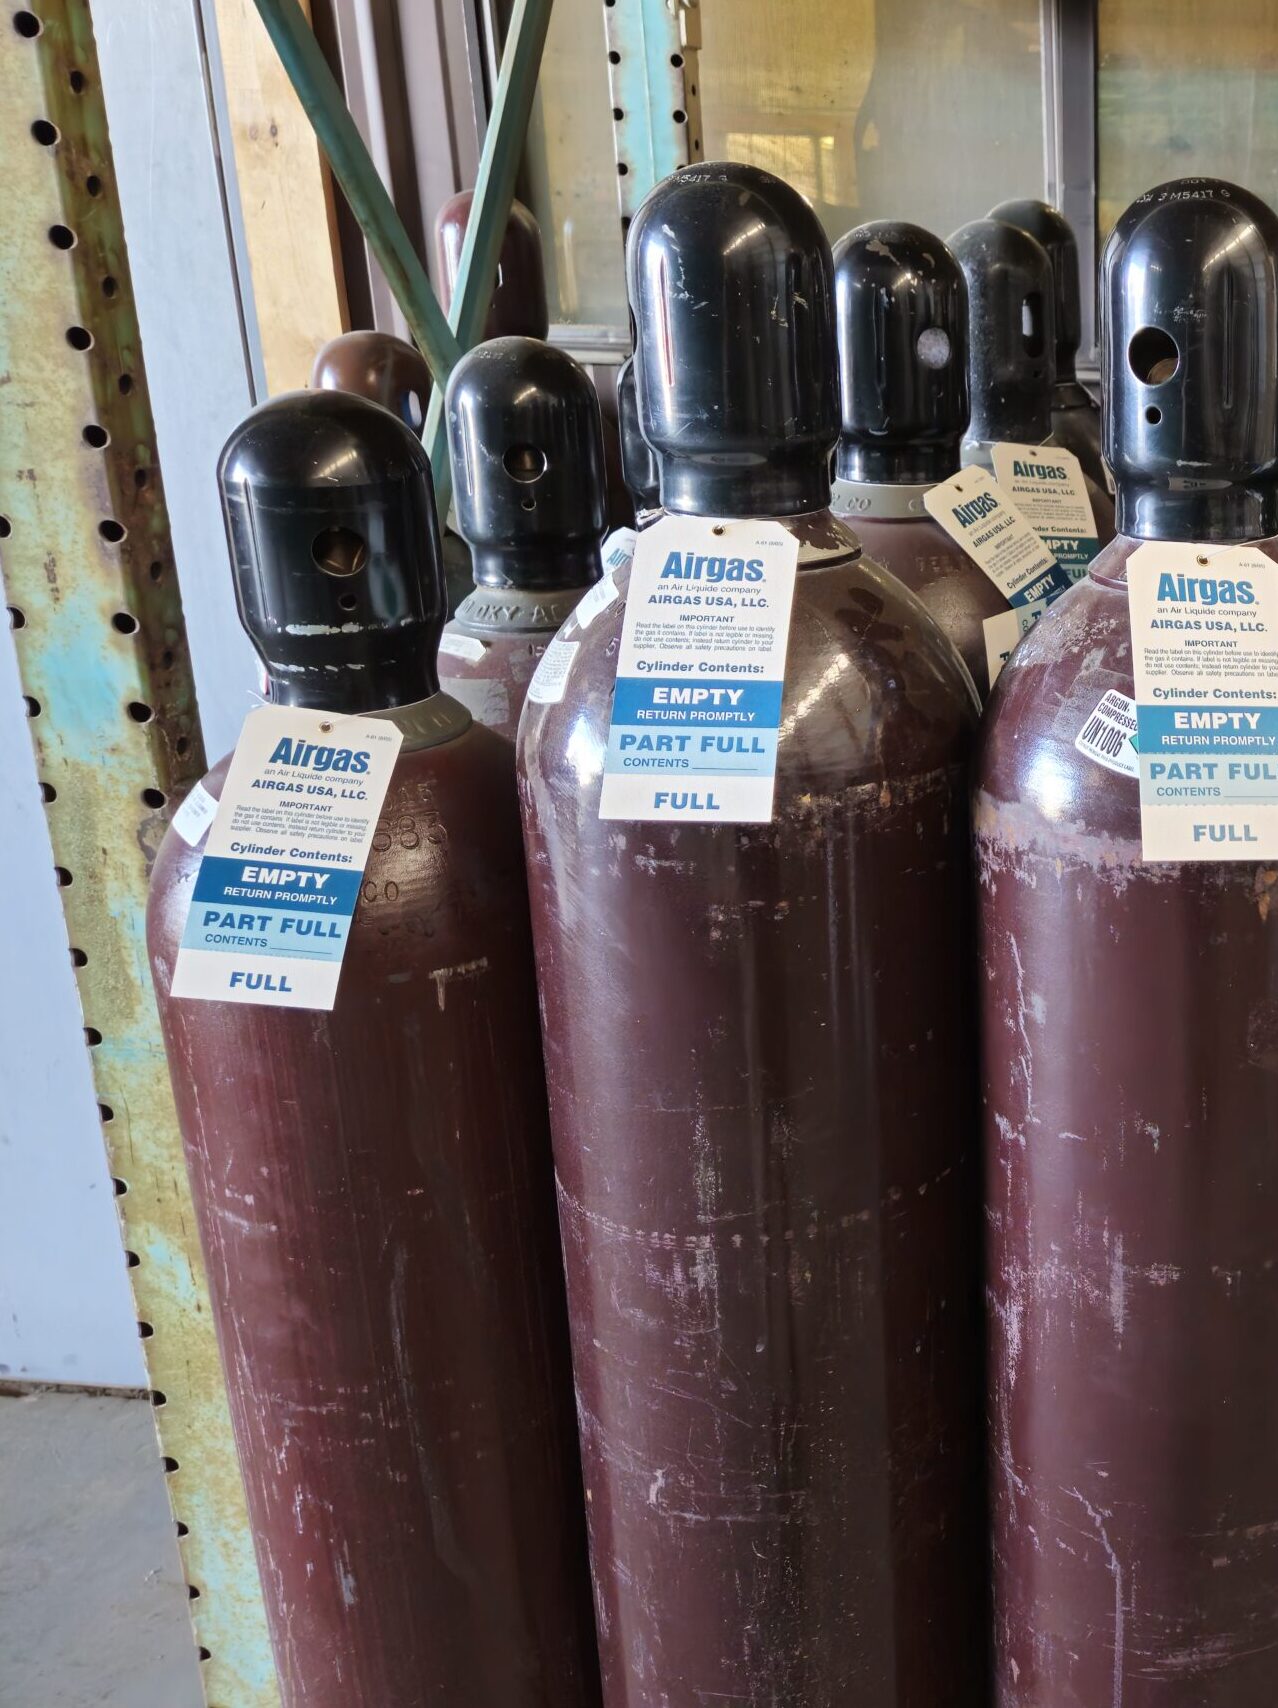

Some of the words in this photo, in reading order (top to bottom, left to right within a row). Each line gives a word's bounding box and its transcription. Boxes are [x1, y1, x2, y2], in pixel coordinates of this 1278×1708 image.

[1013, 461, 1067, 479] Airgas
[1012, 486, 1040, 494] AIRGAS
[952, 492, 998, 528] Airgas
[973, 529, 994, 548] AIRGAS
[1047, 540, 1078, 550] PTY
[660, 552, 764, 582] Airgas
[686, 584, 718, 592] Liquide
[720, 586, 760, 594] company
[1007, 572, 1027, 589] Cylinder
[1024, 574, 1055, 602] EMPTY
[1157, 573, 1255, 605] Airgas
[648, 594, 701, 605] AIRGAS
[705, 596, 738, 607] USA,
[741, 598, 770, 607] LLC.
[679, 614, 734, 622] IMPORTANT
[1184, 607, 1215, 615] Liquide
[1218, 609, 1256, 617] company
[1150, 619, 1201, 629] AIRGAS
[1205, 621, 1236, 632] USA,
[1240, 622, 1267, 631] LLC.
[1184, 639, 1238, 647] IMPORTANT
[636, 660, 694, 672] Cylinder
[697, 662, 764, 673] Contents:
[652, 687, 743, 705] EMPTY
[1152, 687, 1208, 699] Cylinder
[1212, 688, 1276, 699] Contents:
[1105, 692, 1130, 712] ARGON,
[636, 710, 685, 719] RETURN
[689, 711, 755, 721] PROMPTLY
[1174, 711, 1261, 729] EMPTY
[619, 734, 691, 751] PART
[700, 736, 766, 753] FULL
[1081, 715, 1127, 758] UN1006
[1161, 735, 1209, 744] RETURN
[1213, 736, 1276, 745] PROMPTLY
[269, 737, 371, 774] Airgas
[623, 757, 689, 767] CONTENTS
[291, 771, 322, 781] Liquide
[324, 775, 363, 786] company
[1149, 762, 1218, 779] PART
[252, 778, 303, 792] AIRGAS
[306, 785, 338, 798] USA,
[340, 789, 368, 800] LLC.
[1156, 786, 1220, 796] CONTENTS
[279, 800, 332, 812] IMPORTANT
[653, 792, 721, 809] FULL
[1193, 824, 1257, 841] FULL
[229, 841, 285, 857] Cylinder
[289, 847, 352, 863] Contents:
[241, 865, 329, 889] EMPTY
[223, 886, 271, 899] RETURN
[274, 891, 337, 905] PROMPTLY
[202, 910, 272, 932] PART
[279, 917, 343, 938] FULL
[204, 933, 268, 947] CONTENTS
[228, 971, 294, 992] FULL
